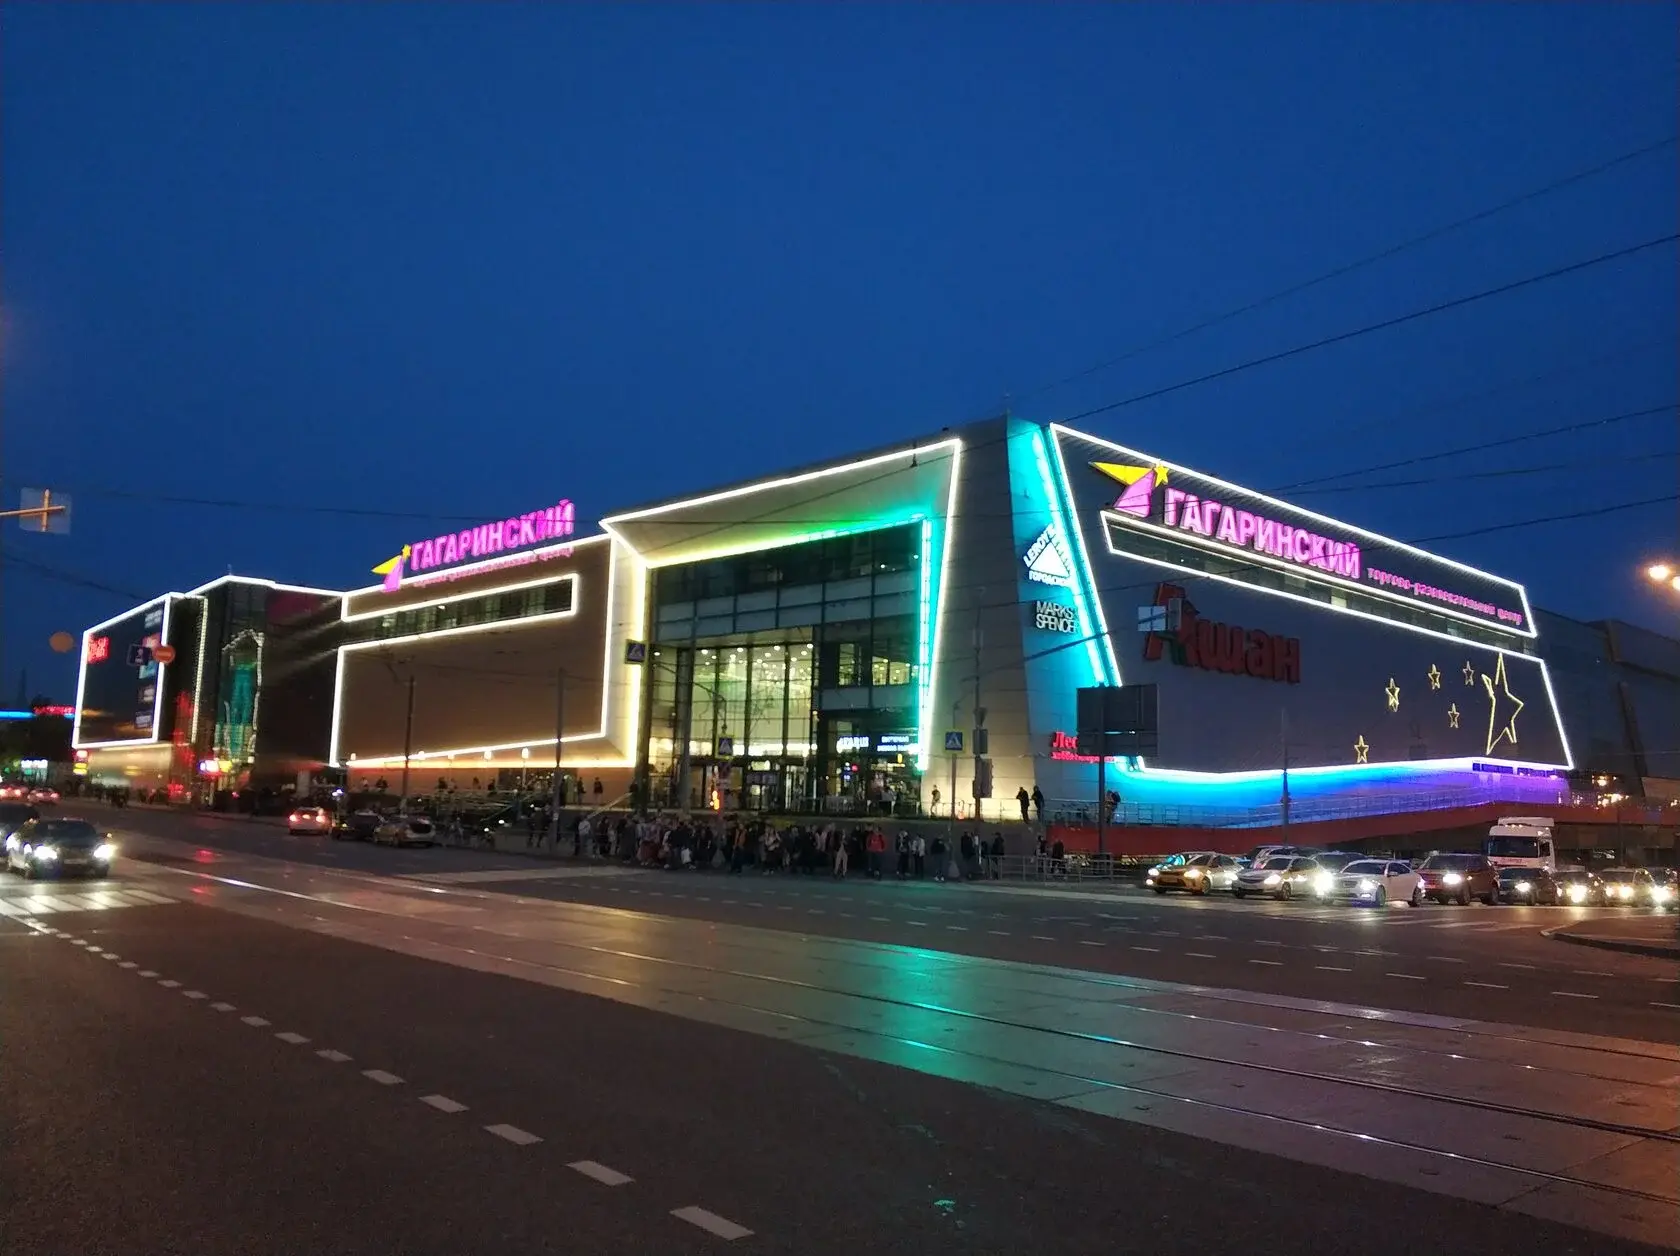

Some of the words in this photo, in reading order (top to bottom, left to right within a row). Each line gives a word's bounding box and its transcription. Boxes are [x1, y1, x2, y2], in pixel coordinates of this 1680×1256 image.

[410, 498, 575, 570] ГАГАРИНСКИЙ
[1024, 530, 1050, 568] LEROY
[1163, 488, 1361, 580] ГАГАРИНСКИЙ
[1036, 600, 1074, 619] MARKS
[1036, 613, 1076, 633] SPENCE
[1143, 582, 1300, 683] Ашан
